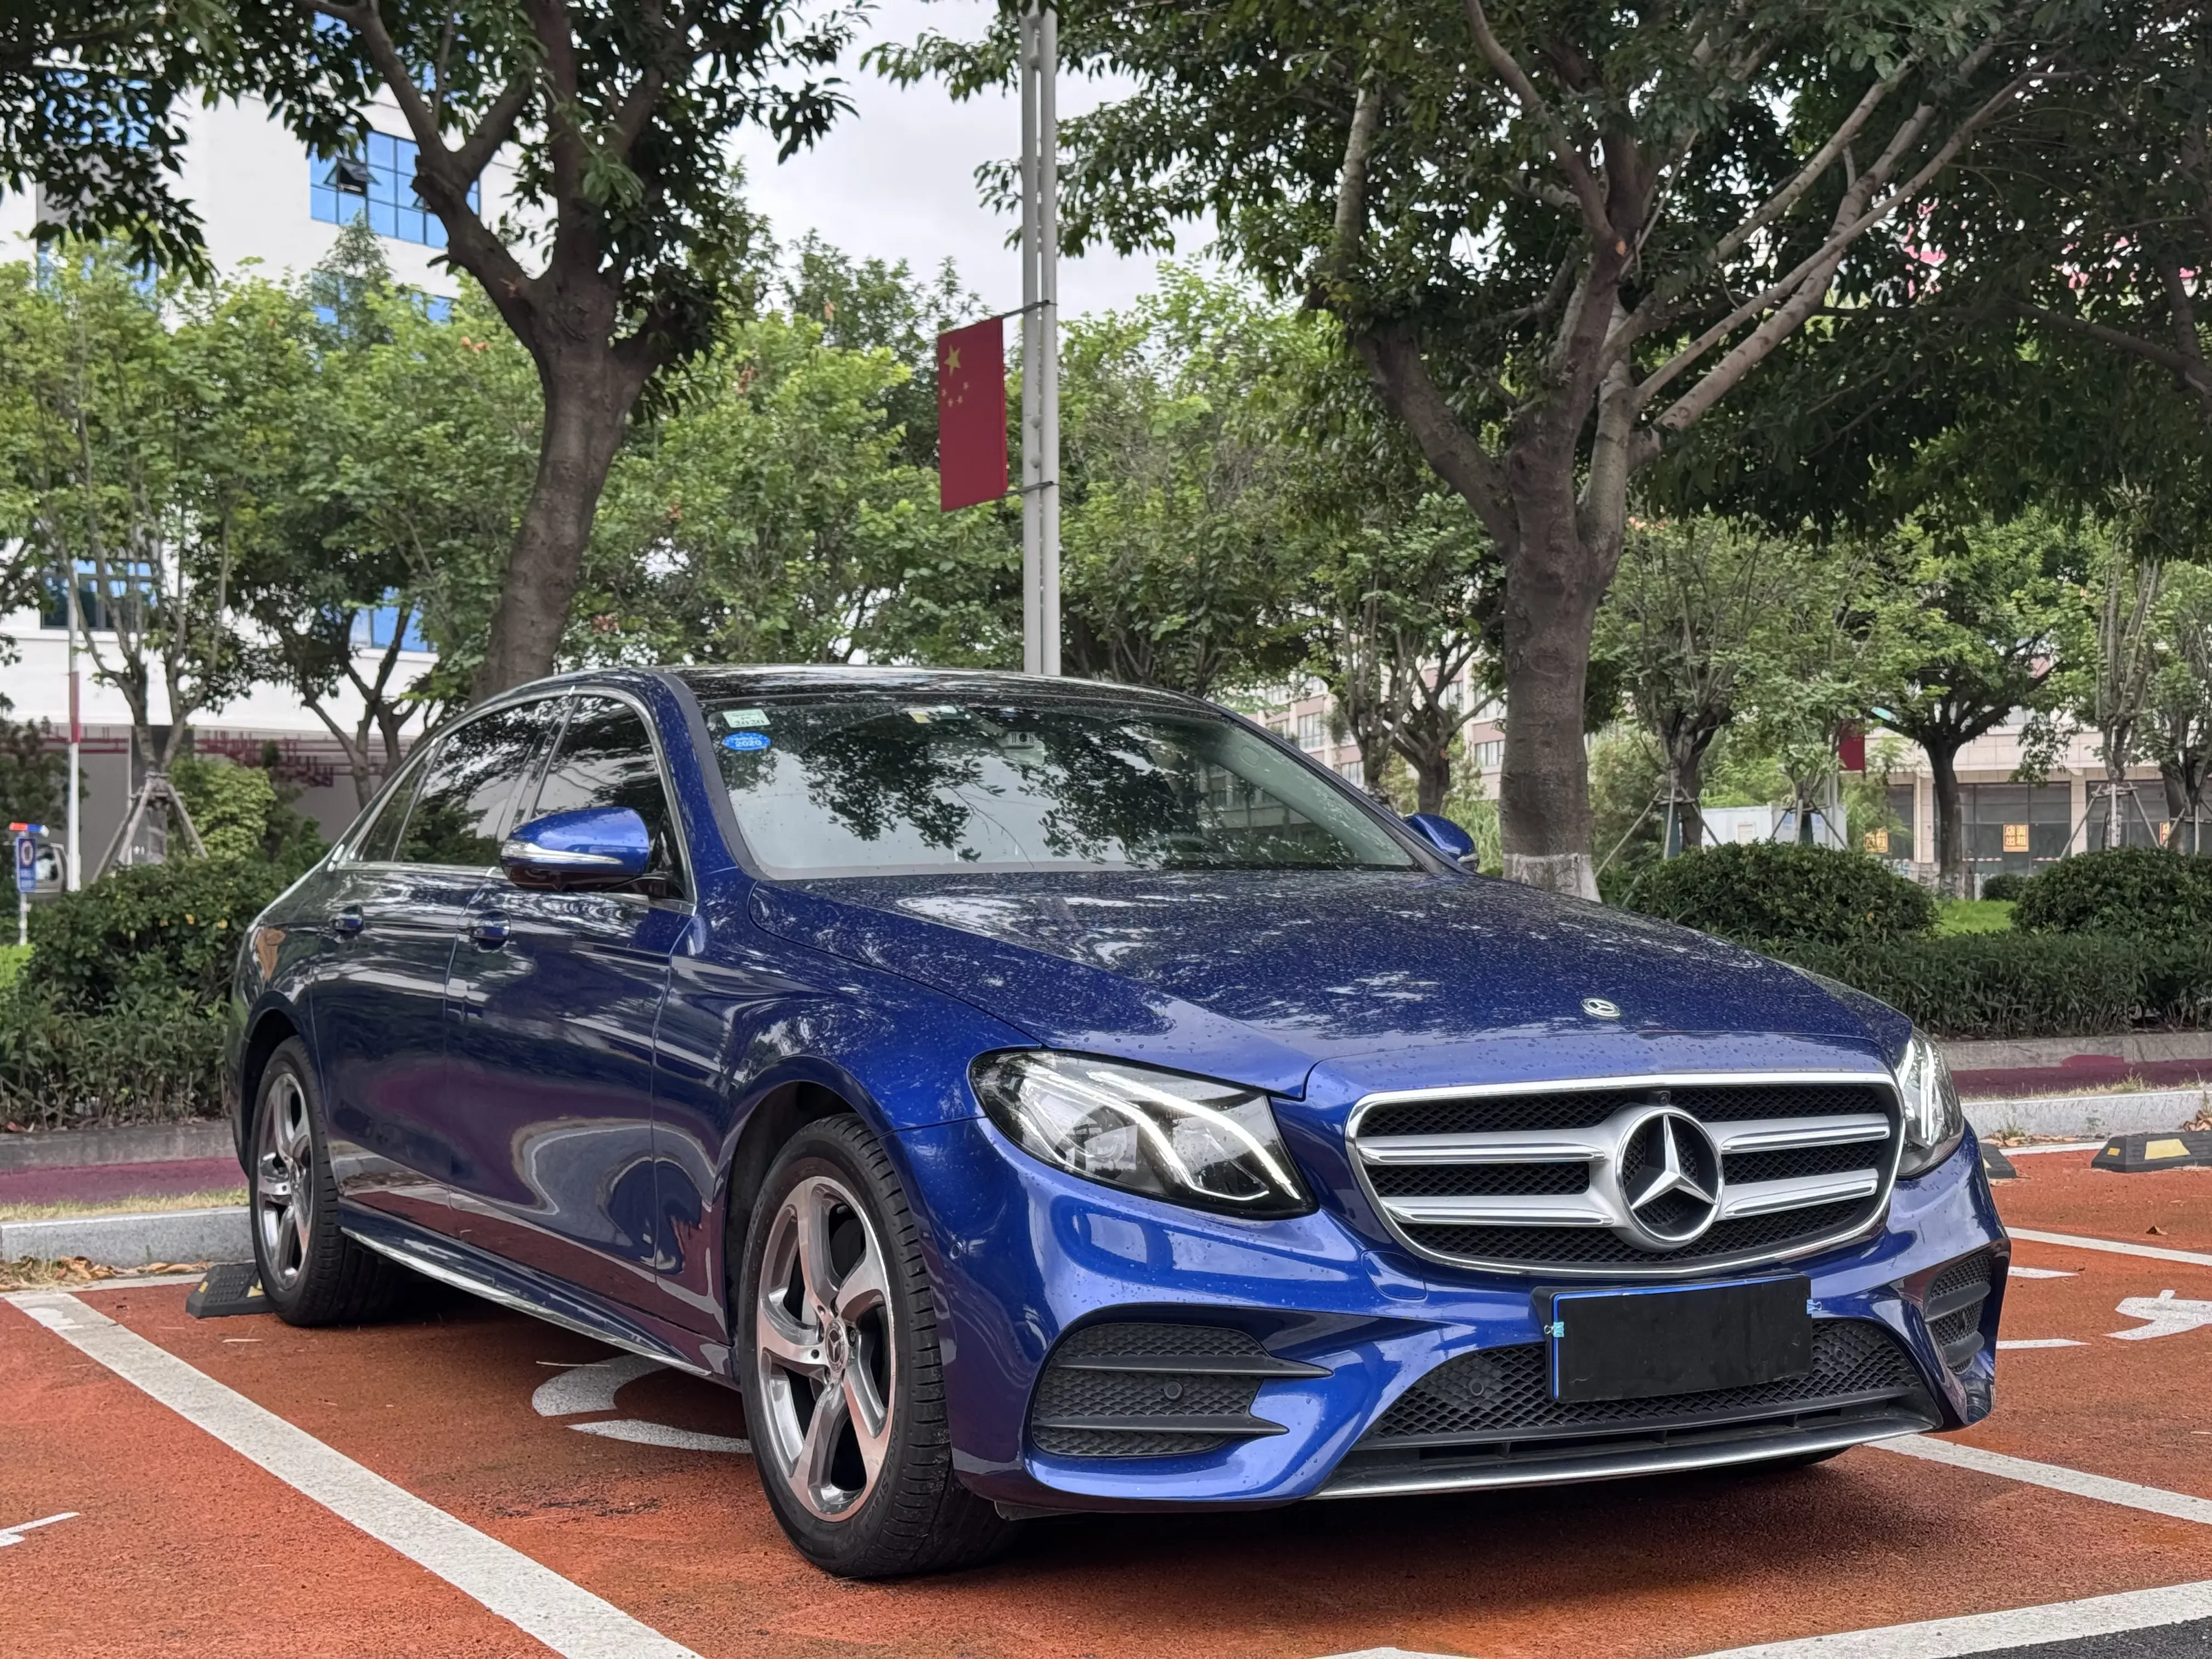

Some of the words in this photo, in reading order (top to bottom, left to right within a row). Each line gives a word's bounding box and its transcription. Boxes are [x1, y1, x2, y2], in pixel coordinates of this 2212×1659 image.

[735, 738, 763, 747] 2020
[2005, 826, 2027, 836] 店面
[2005, 836, 2027, 846] 出租
